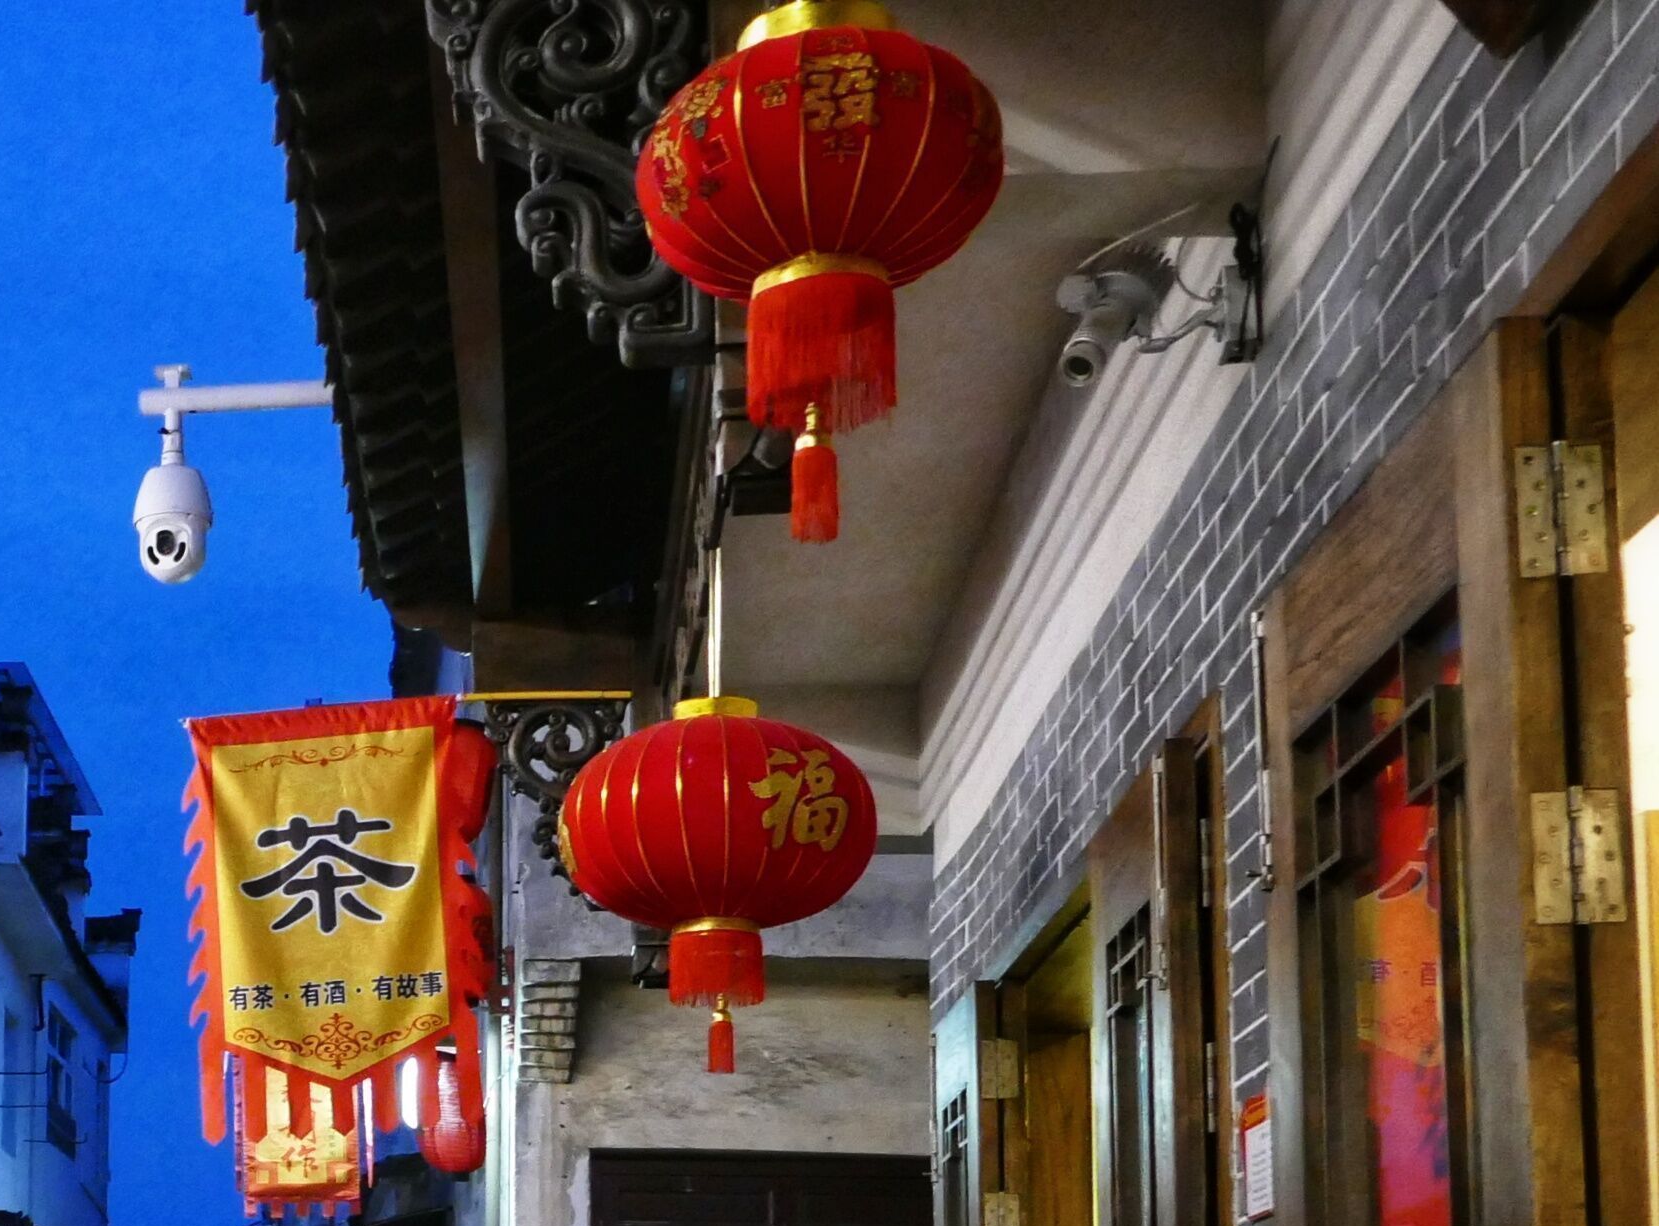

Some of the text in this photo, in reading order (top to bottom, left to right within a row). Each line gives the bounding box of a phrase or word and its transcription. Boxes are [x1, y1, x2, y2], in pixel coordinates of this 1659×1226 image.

[748, 747, 849, 852] 福
[241, 809, 415, 934] 茶
[229, 971, 443, 1010] 有茶·有酒·有故事
